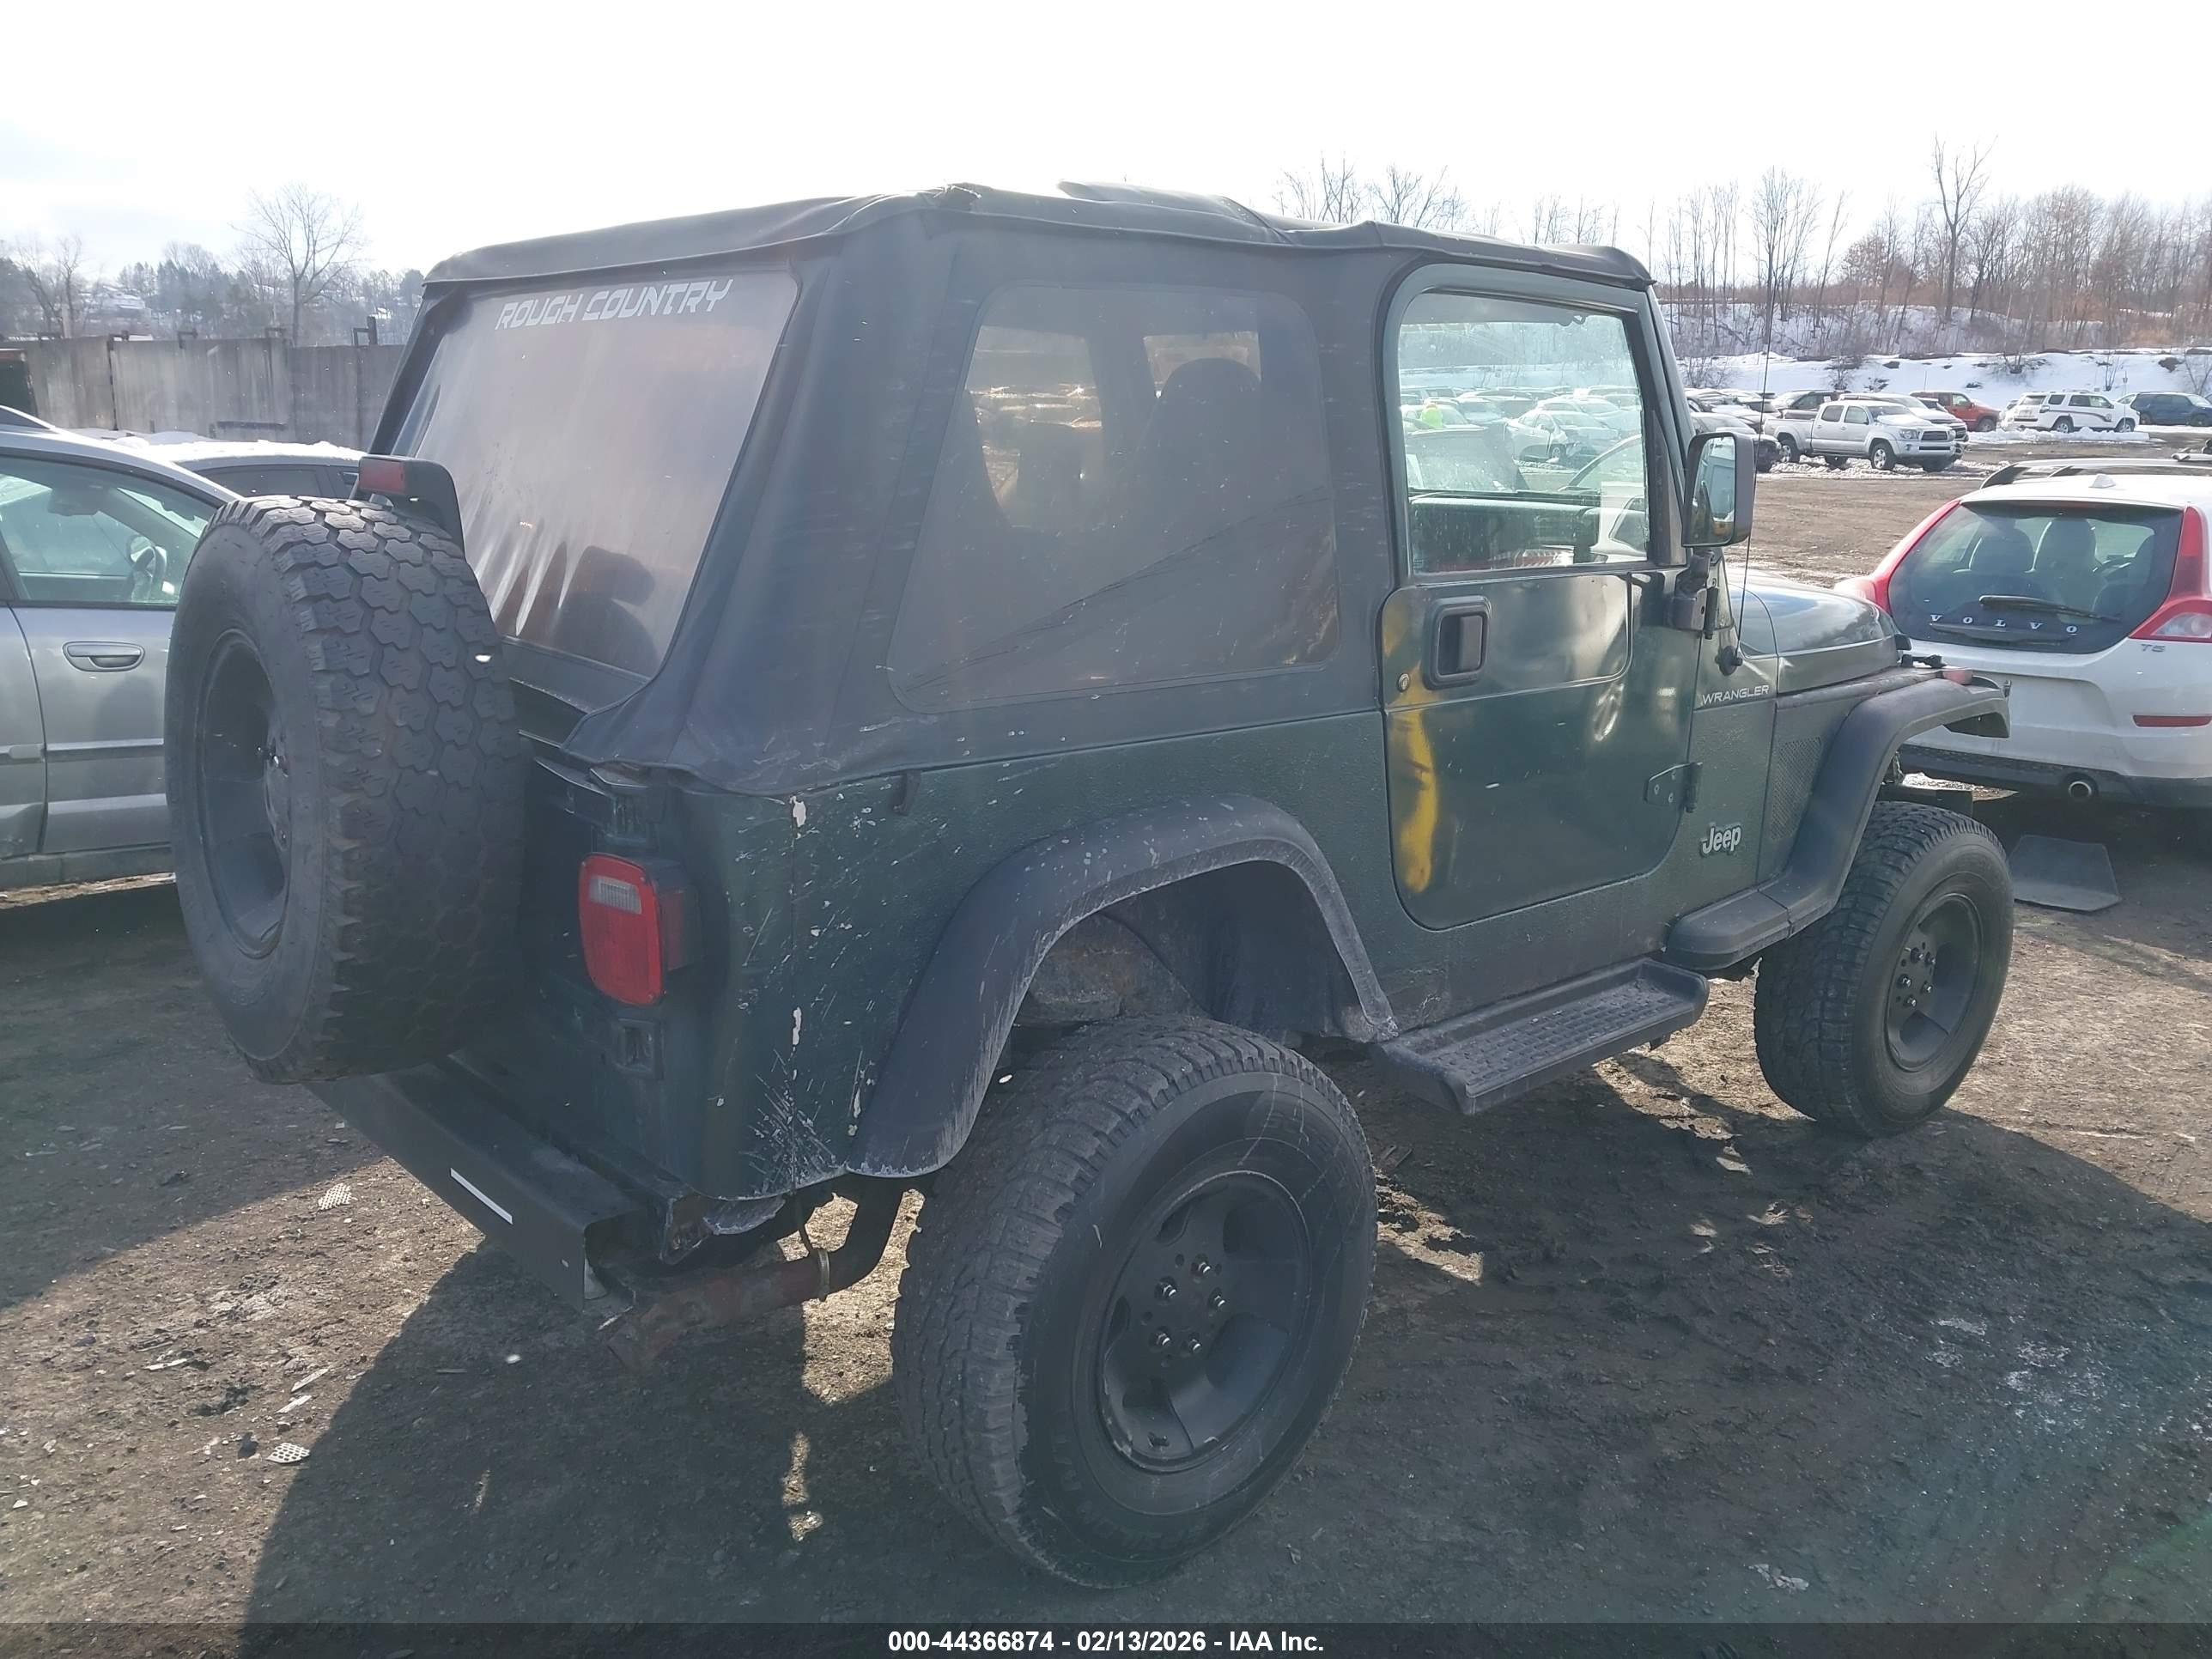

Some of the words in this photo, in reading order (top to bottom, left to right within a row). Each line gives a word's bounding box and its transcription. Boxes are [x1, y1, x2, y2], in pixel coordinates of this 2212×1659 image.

[495, 294, 584, 330] ROUGH
[581, 279, 733, 321] COUNTRY
[1929, 614, 2078, 634] VOLVO
[1702, 685, 1770, 705] WRANGLER
[1701, 825, 1741, 854] Jeep
